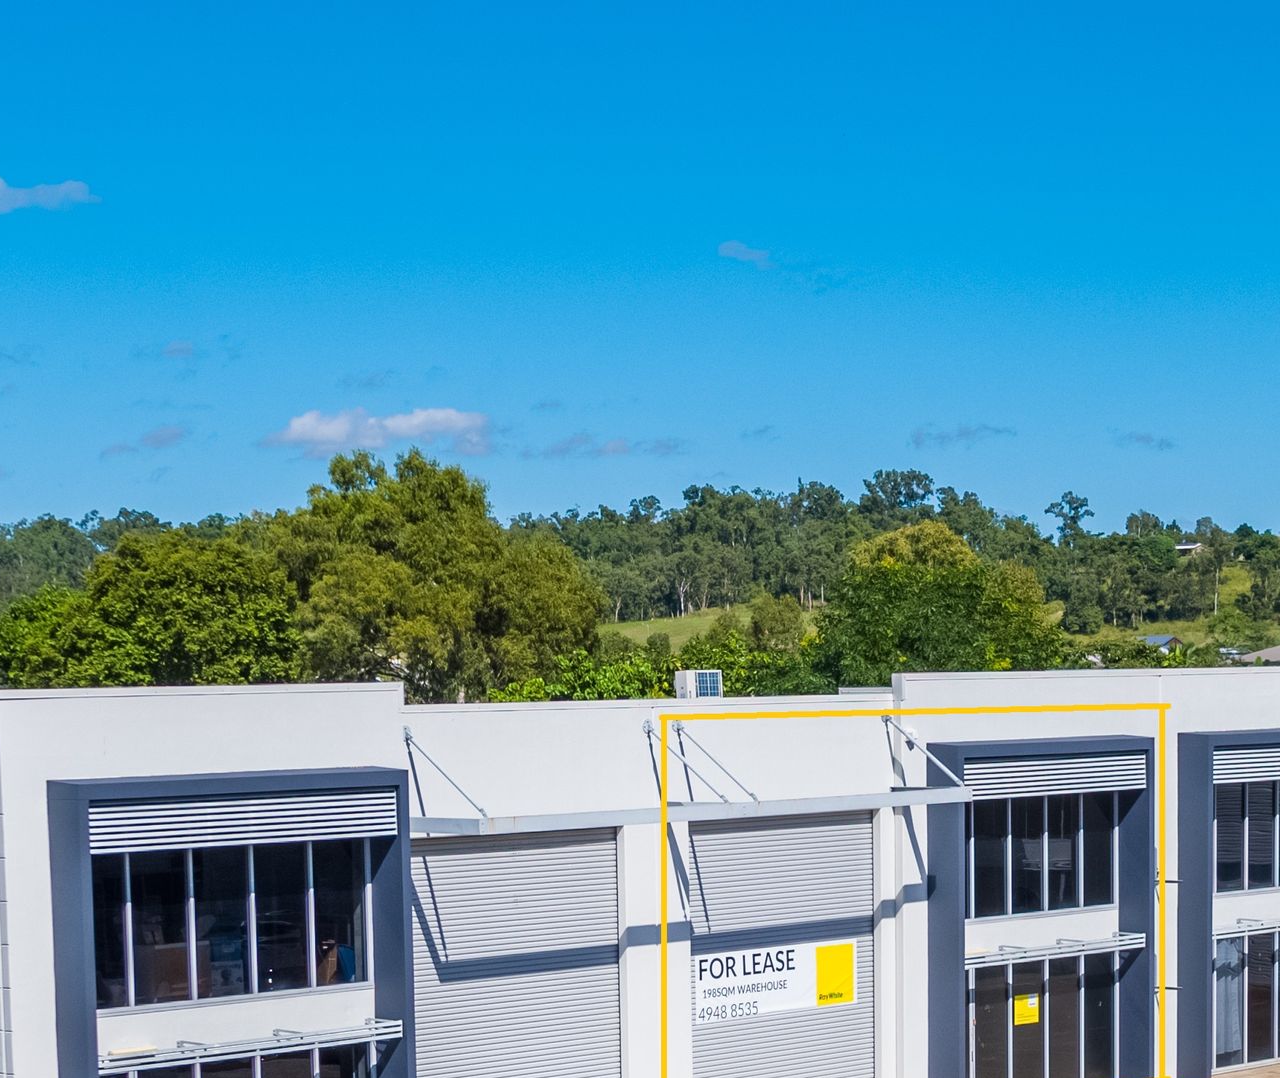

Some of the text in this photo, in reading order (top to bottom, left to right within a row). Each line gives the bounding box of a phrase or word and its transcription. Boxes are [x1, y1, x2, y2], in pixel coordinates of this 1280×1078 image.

[698, 949, 796, 981] FOR LEASE
[703, 979, 788, 999] 198SQM WAREHOUSE
[698, 1001, 759, 1021] 4948 8535
